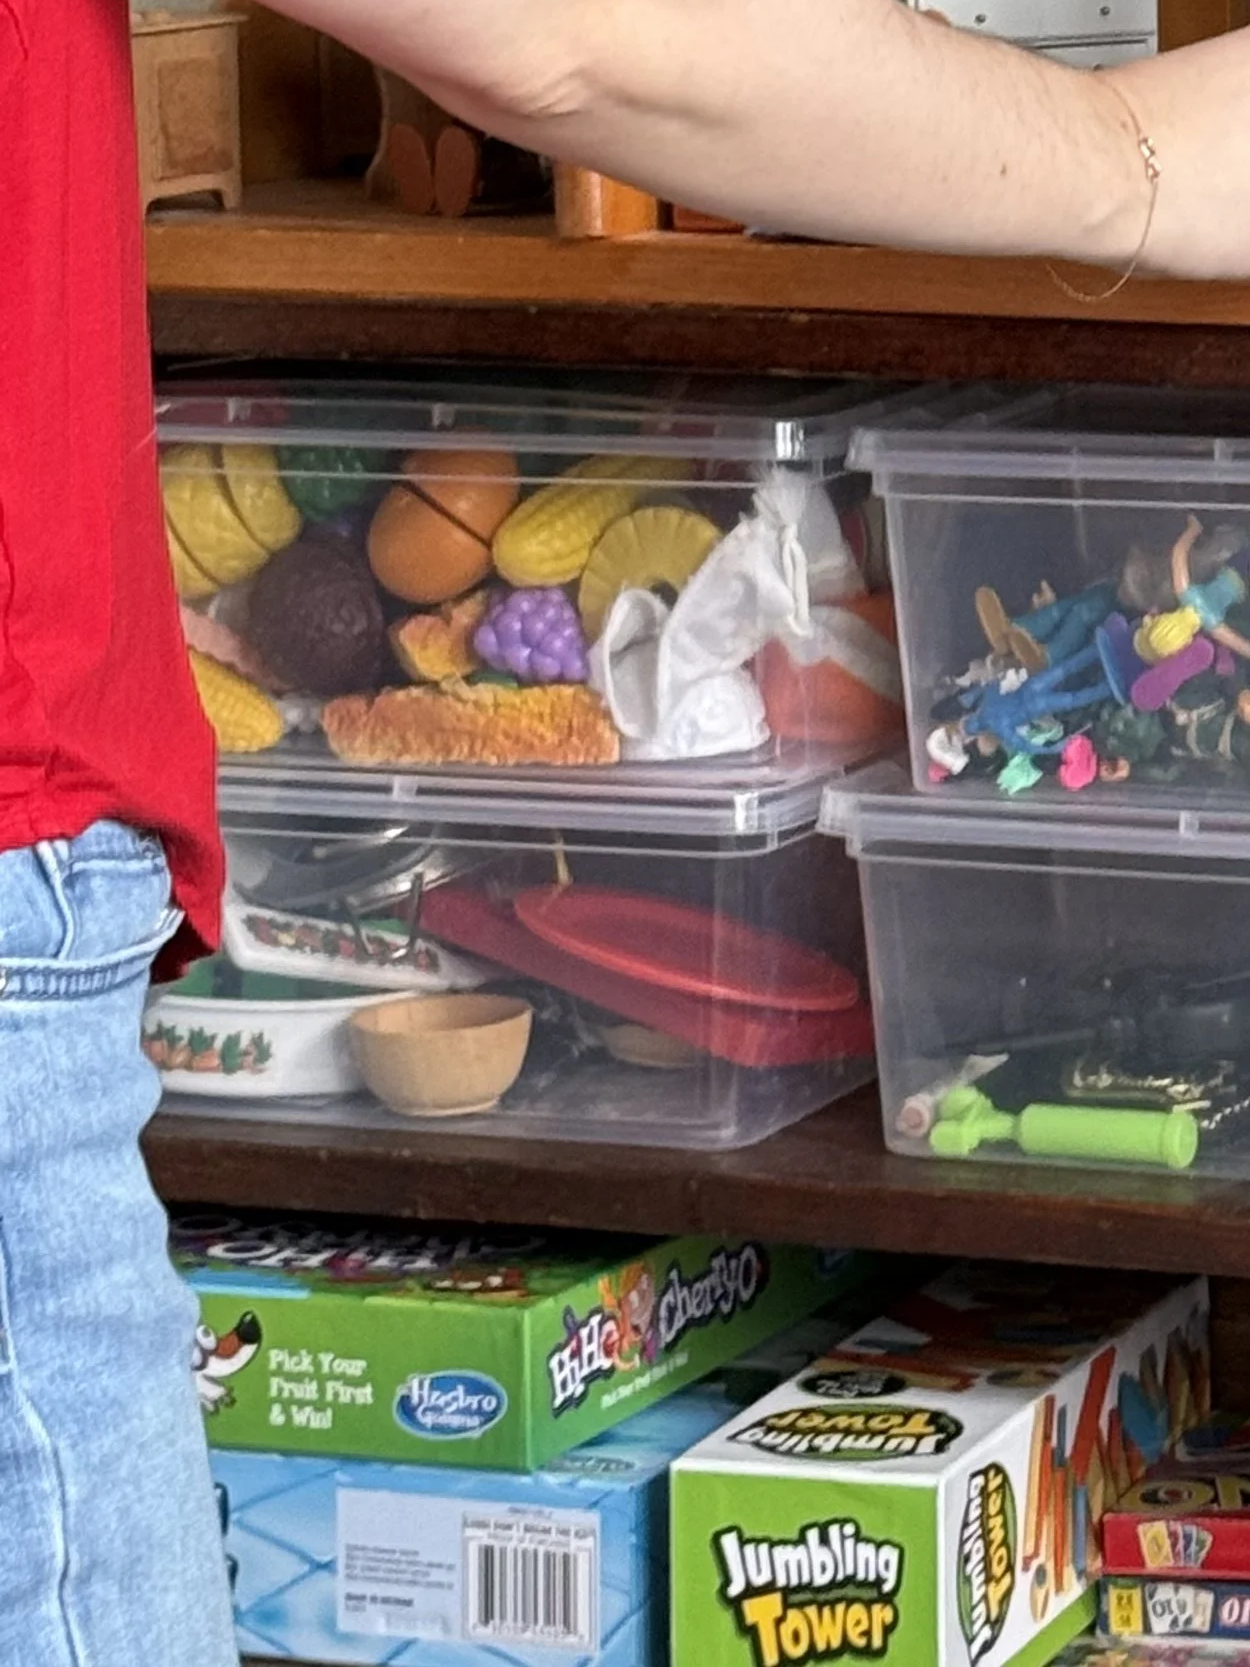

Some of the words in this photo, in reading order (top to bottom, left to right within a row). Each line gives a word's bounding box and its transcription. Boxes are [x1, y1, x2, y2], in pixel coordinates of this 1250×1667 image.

[268, 1348, 314, 1373] Pick
[317, 1352, 367, 1377] Your
[269, 1377, 319, 1402] Fruit
[325, 1380, 374, 1405] First
[411, 1377, 498, 1412] Hasbro
[269, 1403, 286, 1426] &
[765, 1409, 936, 1435] Tower
[736, 1426, 946, 1455] Jumbling
[717, 1521, 901, 1598] Jumbling
[985, 1468, 1013, 1622] Tower
[963, 1473, 993, 1665] Jumbling
[1218, 1597, 1250, 1627] 10
[741, 1591, 894, 1667] Tower
